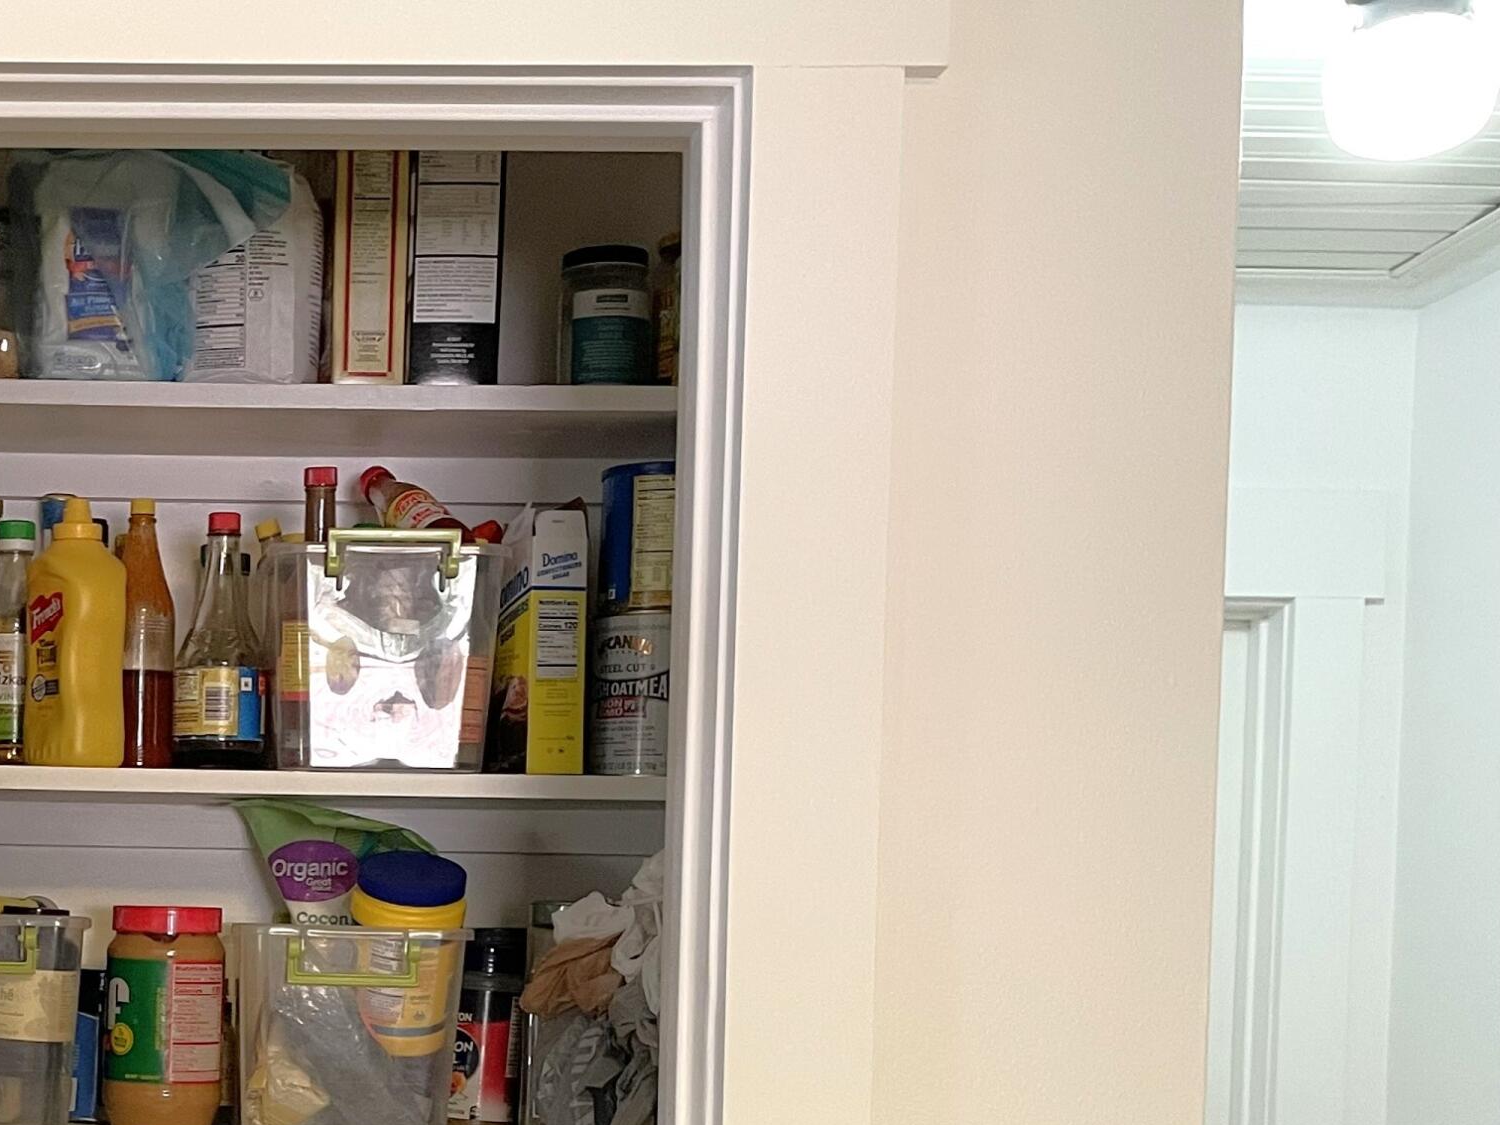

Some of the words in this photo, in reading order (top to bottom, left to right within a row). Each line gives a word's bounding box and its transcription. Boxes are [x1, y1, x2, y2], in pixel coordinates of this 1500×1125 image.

[542, 552, 579, 567] Domino
[626, 663, 646, 673] CUT
[610, 673, 668, 700] OATMEA
[272, 857, 348, 882] Organic
[297, 911, 350, 926] Cocon
